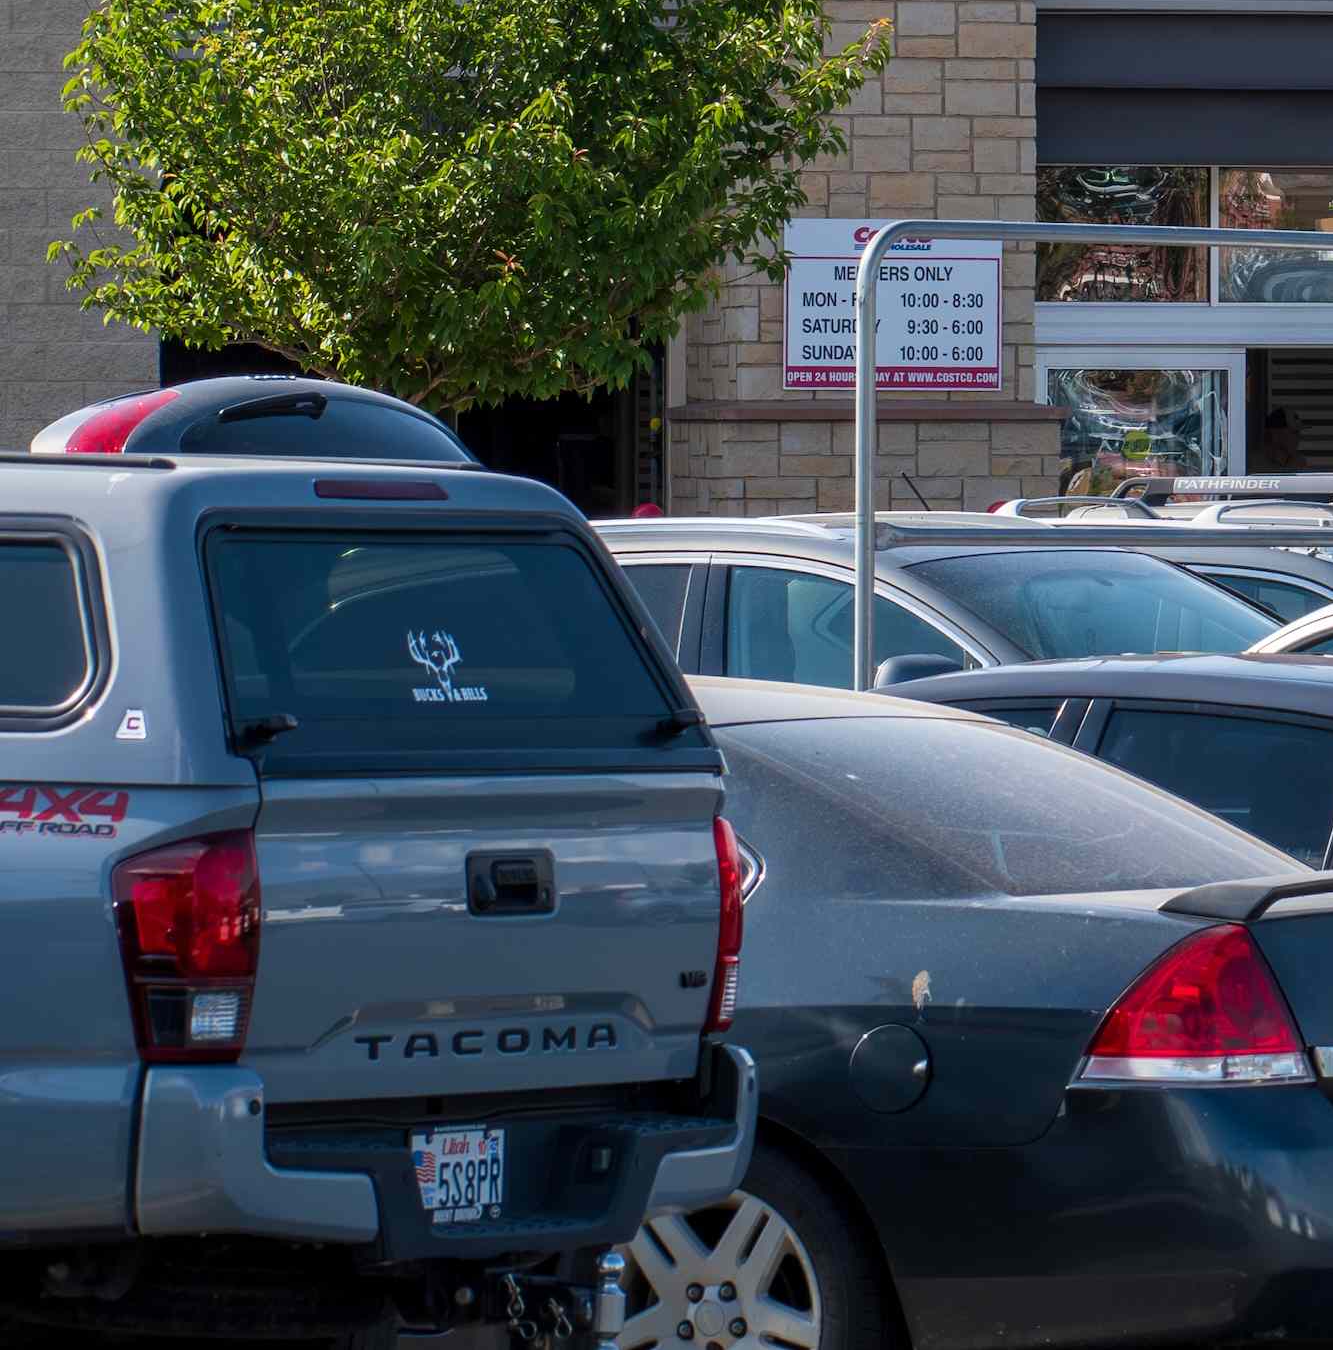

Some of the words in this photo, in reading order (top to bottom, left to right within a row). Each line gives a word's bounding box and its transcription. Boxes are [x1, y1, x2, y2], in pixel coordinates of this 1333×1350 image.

[834, 266, 909, 282] MEERS
[914, 266, 953, 282] ONLY
[802, 292, 837, 307] MON
[900, 293, 939, 308] 10:00
[952, 293, 984, 308] 8:30
[802, 319, 881, 334] SATURY
[907, 320, 939, 335] 9:30
[952, 320, 984, 335] 6:00
[900, 346, 939, 361] 10:00
[952, 346, 984, 362] 6:00
[787, 371, 812, 382] OPEN
[815, 371, 827, 382] 24
[829, 372, 856, 382] HOUR
[893, 372, 904, 382] AT
[908, 372, 997, 383] WWW.COSTCO.COM
[1177, 479, 1281, 490] PATHFINDER
[126, 717, 140, 730] C
[0, 820, 34, 834] FF
[38, 822, 117, 838] ROAD
[354, 1023, 618, 1060] TACOMA
[439, 1157, 501, 1206] 5S8PR
